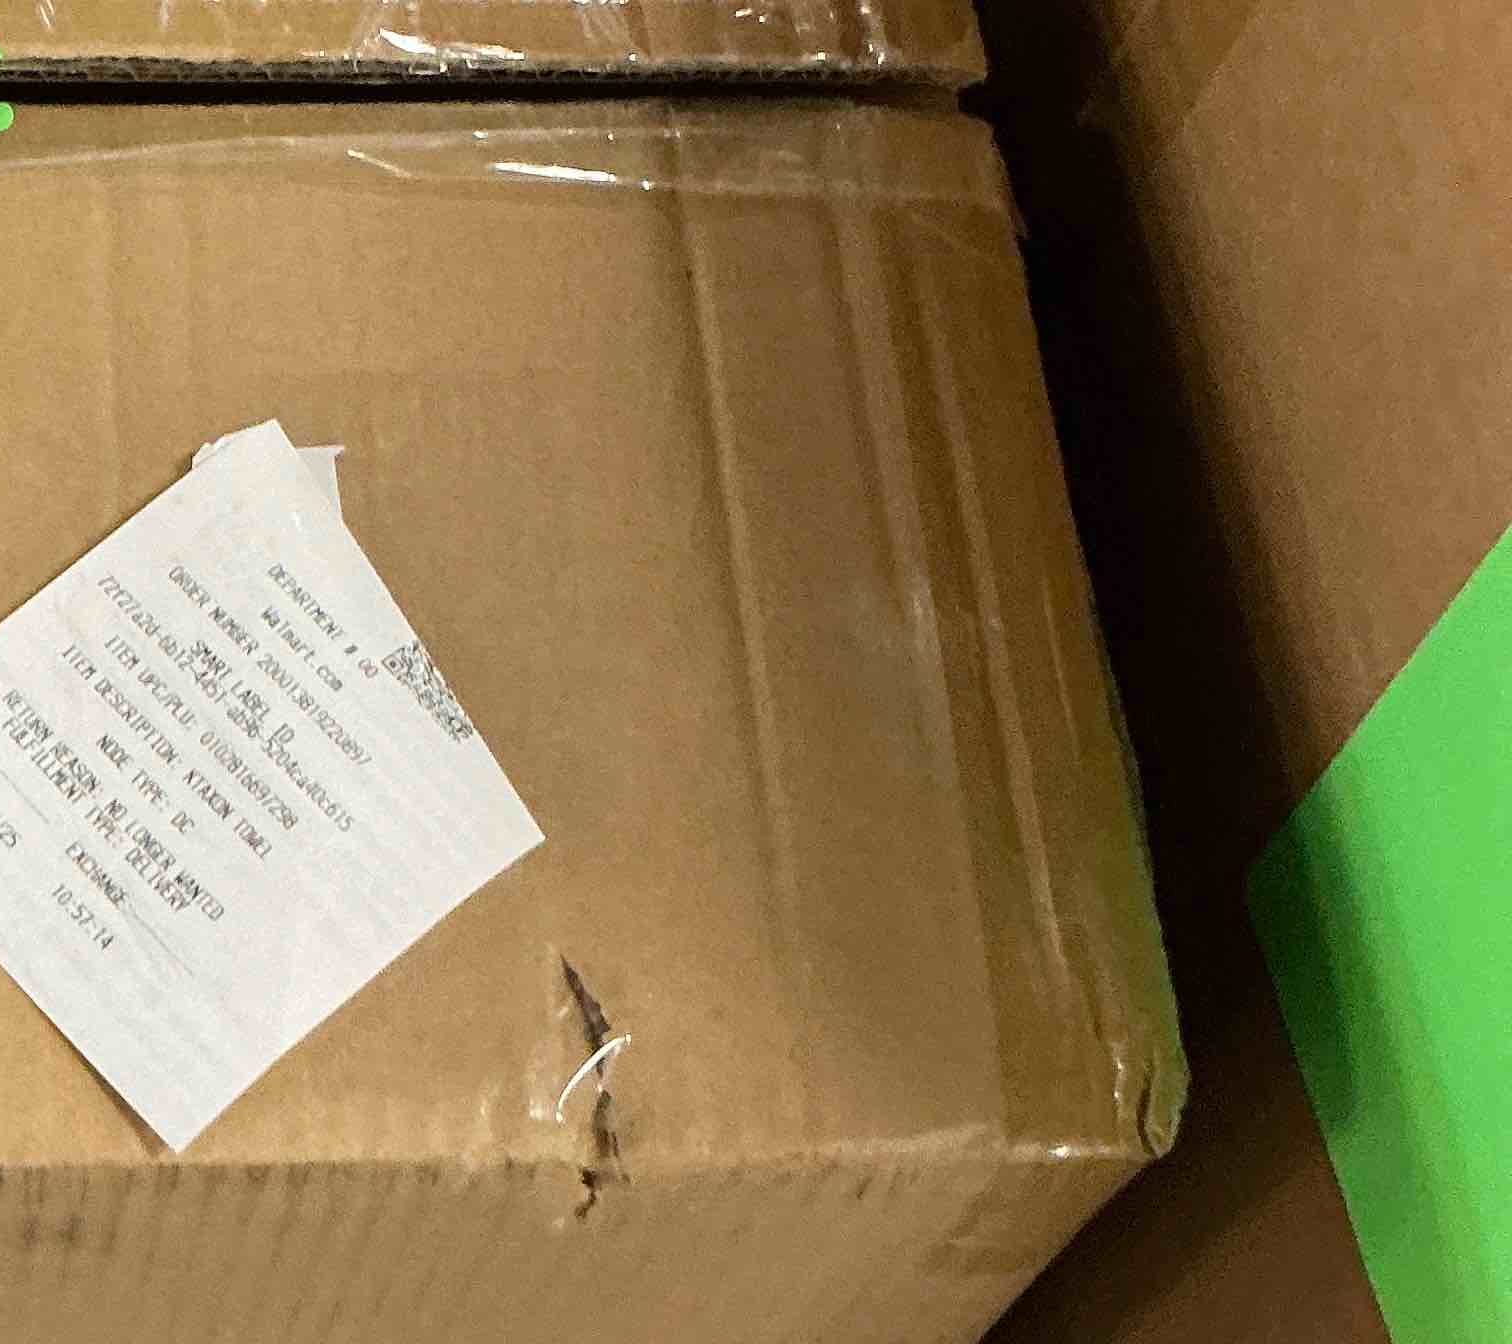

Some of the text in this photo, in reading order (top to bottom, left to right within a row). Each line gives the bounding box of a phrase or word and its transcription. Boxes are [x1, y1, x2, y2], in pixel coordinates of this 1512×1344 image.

[165, 565, 214, 608] ORDER
[206, 604, 262, 656] NUMBER
[264, 561, 345, 642] DEPARTMENT
[187, 638, 234, 681] SMART
[0, 687, 57, 743] RETURN
[0, 715, 86, 806] FULFILLMENT
[122, 846, 192, 915] DELIVERY
